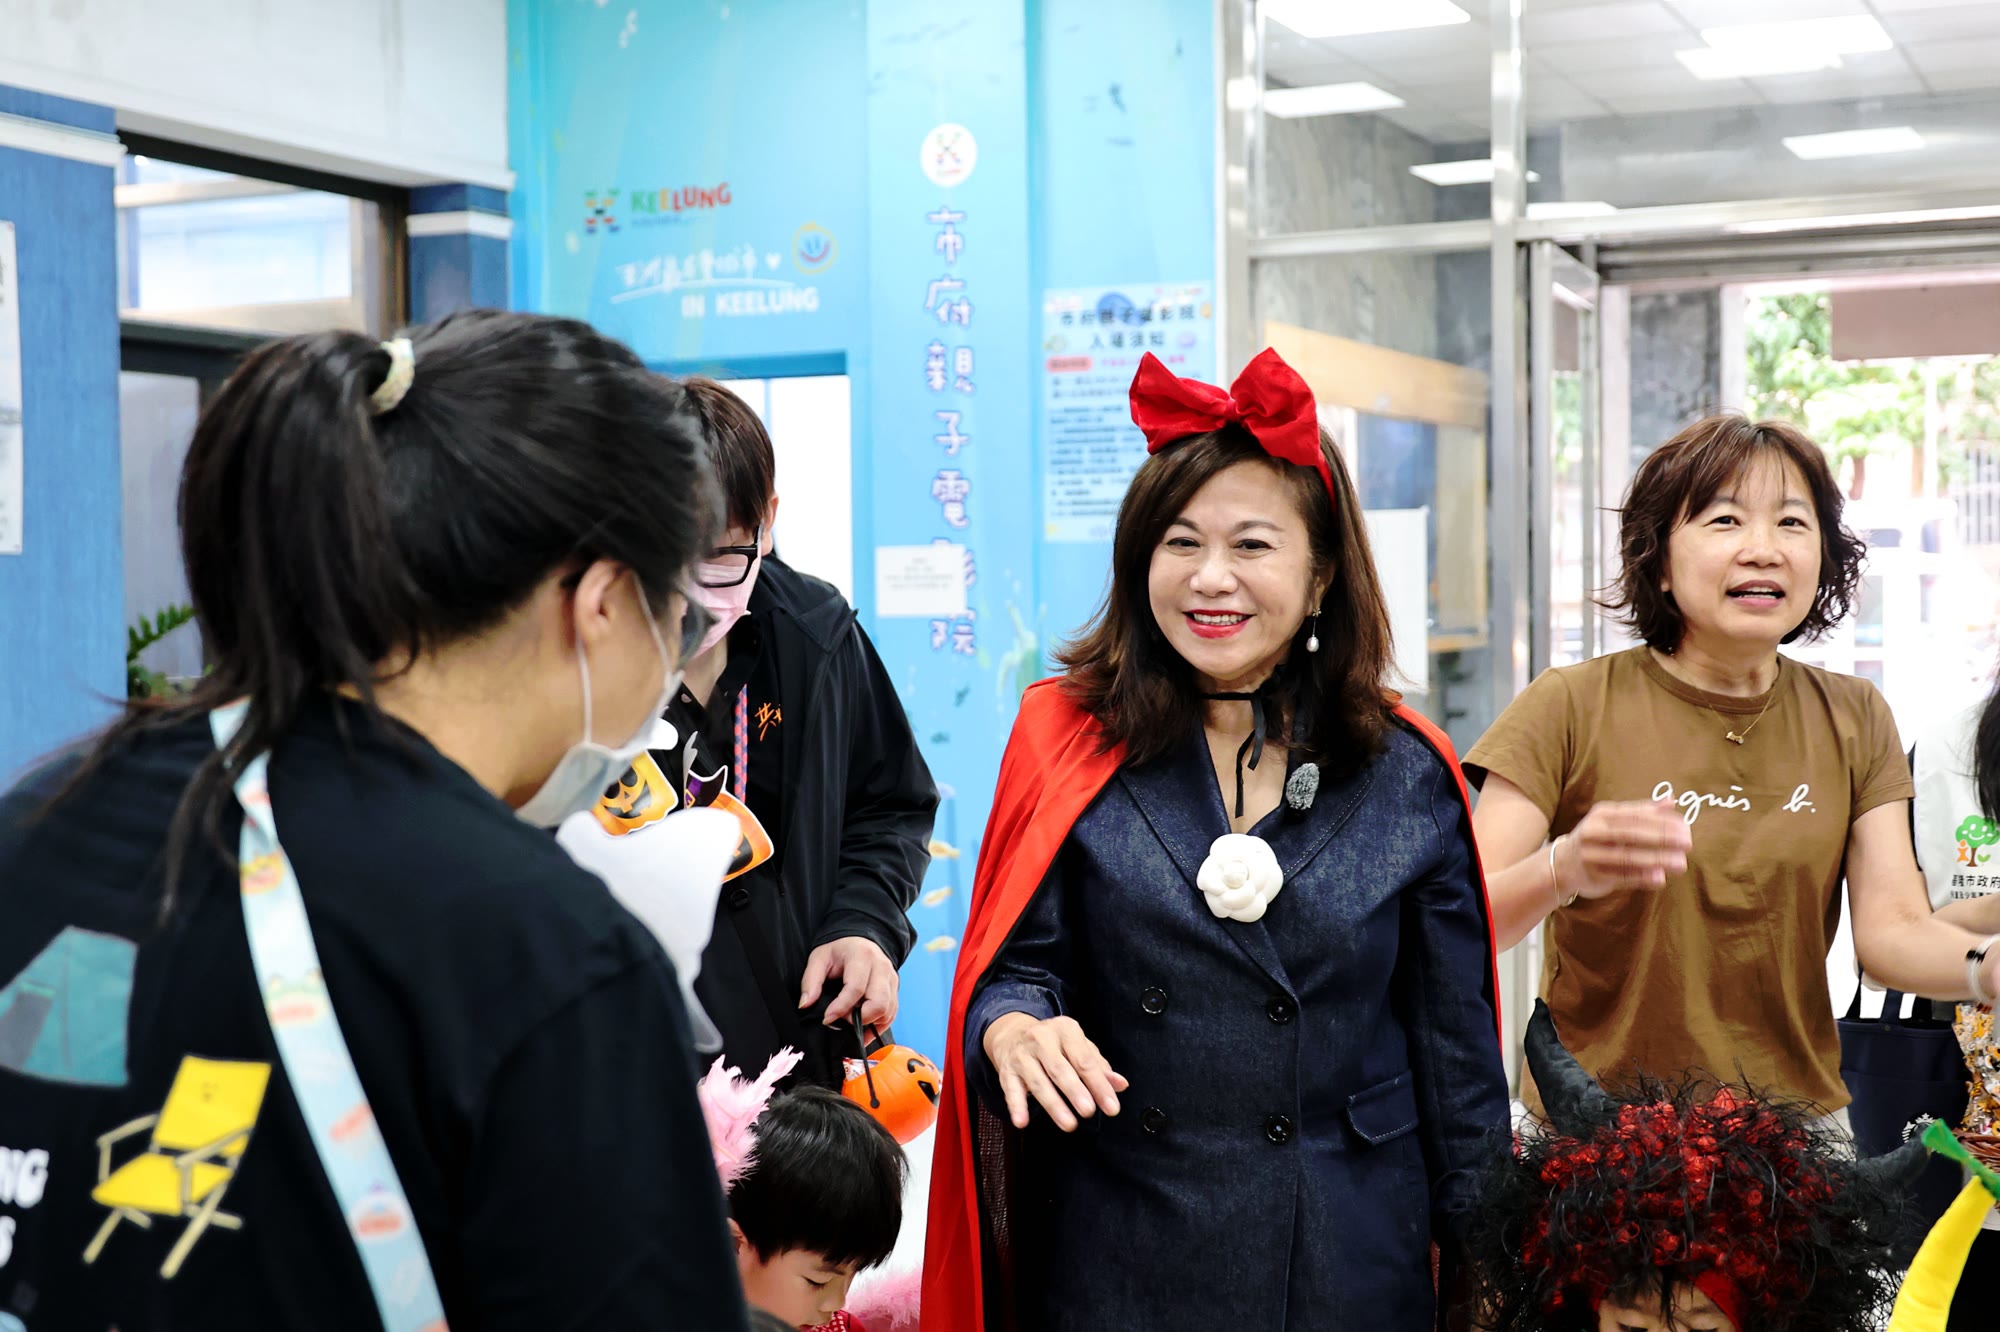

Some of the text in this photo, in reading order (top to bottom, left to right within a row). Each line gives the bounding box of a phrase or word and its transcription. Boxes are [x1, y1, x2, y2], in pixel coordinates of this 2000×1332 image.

[631, 182, 732, 214] KEELUNG
[681, 286, 820, 318] IN KEELUNG
[1782, 784, 1817, 814] b.
